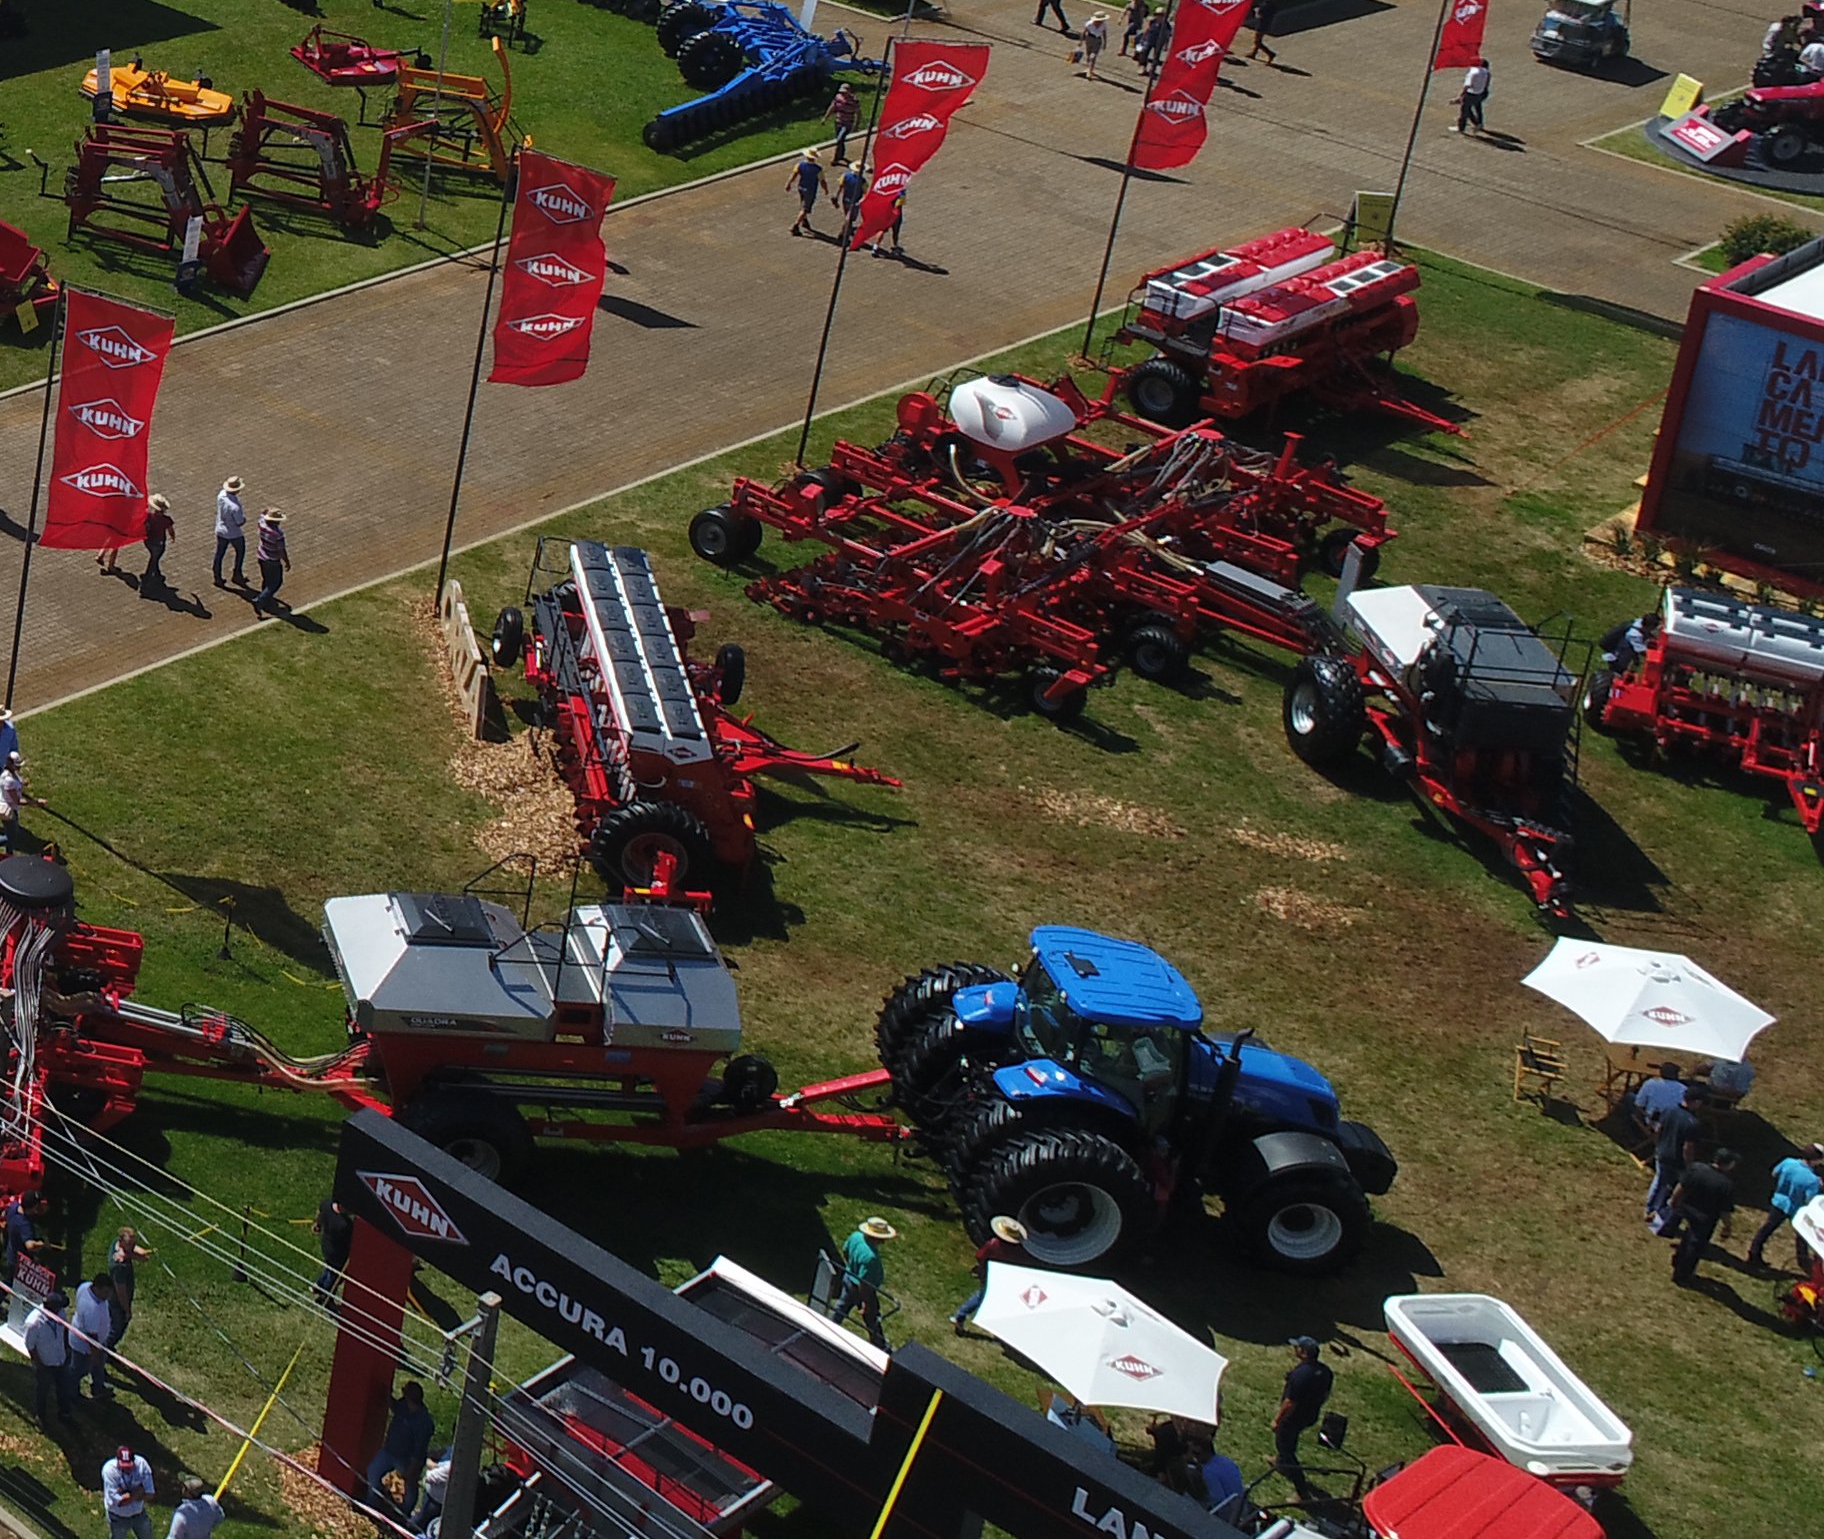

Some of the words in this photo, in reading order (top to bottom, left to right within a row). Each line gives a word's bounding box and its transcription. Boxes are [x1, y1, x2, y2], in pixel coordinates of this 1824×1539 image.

[913, 67, 968, 87] KUHN
[1153, 99, 1200, 118] KUHN
[535, 193, 588, 221] KUHN
[526, 260, 584, 285] KUHN
[516, 316, 575, 336] KUHN
[87, 333, 144, 363] KUHN
[80, 407, 136, 436] KUHN
[76, 470, 137, 496] KUHN
[410, 1017, 458, 1027] QUADRA
[1650, 1011, 1689, 1025] KUHN
[662, 1033, 691, 1041] KUHN
[375, 1180, 451, 1238] KUHN
[489, 1252, 629, 1358] ACCURA
[640, 1343, 755, 1431] 10.000
[1115, 1358, 1155, 1377] KUHN
